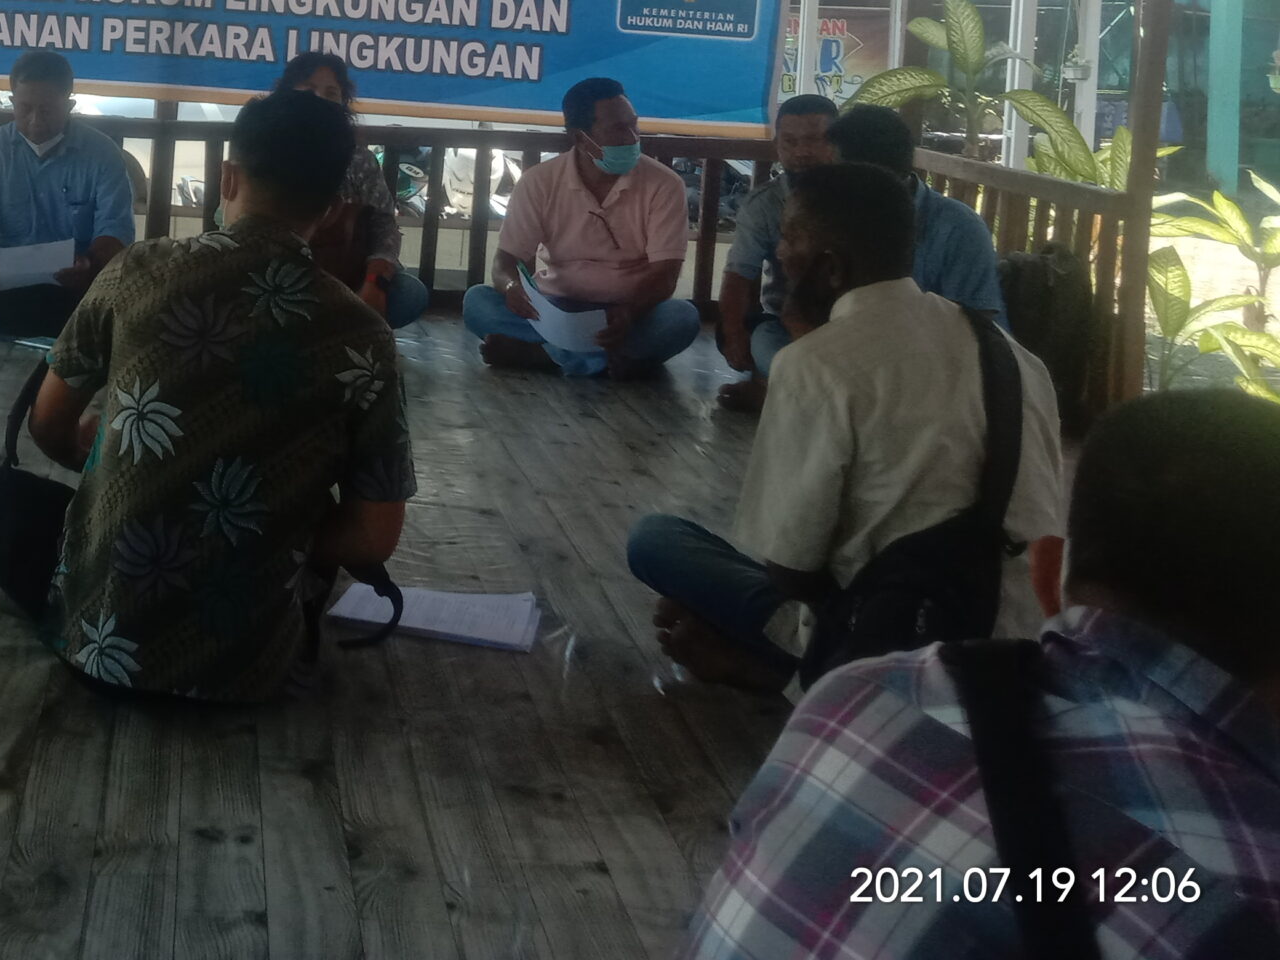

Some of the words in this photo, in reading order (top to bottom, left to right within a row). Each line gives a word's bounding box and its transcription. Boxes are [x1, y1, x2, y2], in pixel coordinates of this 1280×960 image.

[643, 7, 735, 21] KEMENTERIAN
[627, 16, 673, 28] HUKUM
[677, 19, 703, 30] DAN
[706, 22, 734, 32] HAM
[737, 24, 748, 33] RI
[101, 18, 275, 62] PERKARA
[286, 29, 541, 80] LINGKUNGAN
